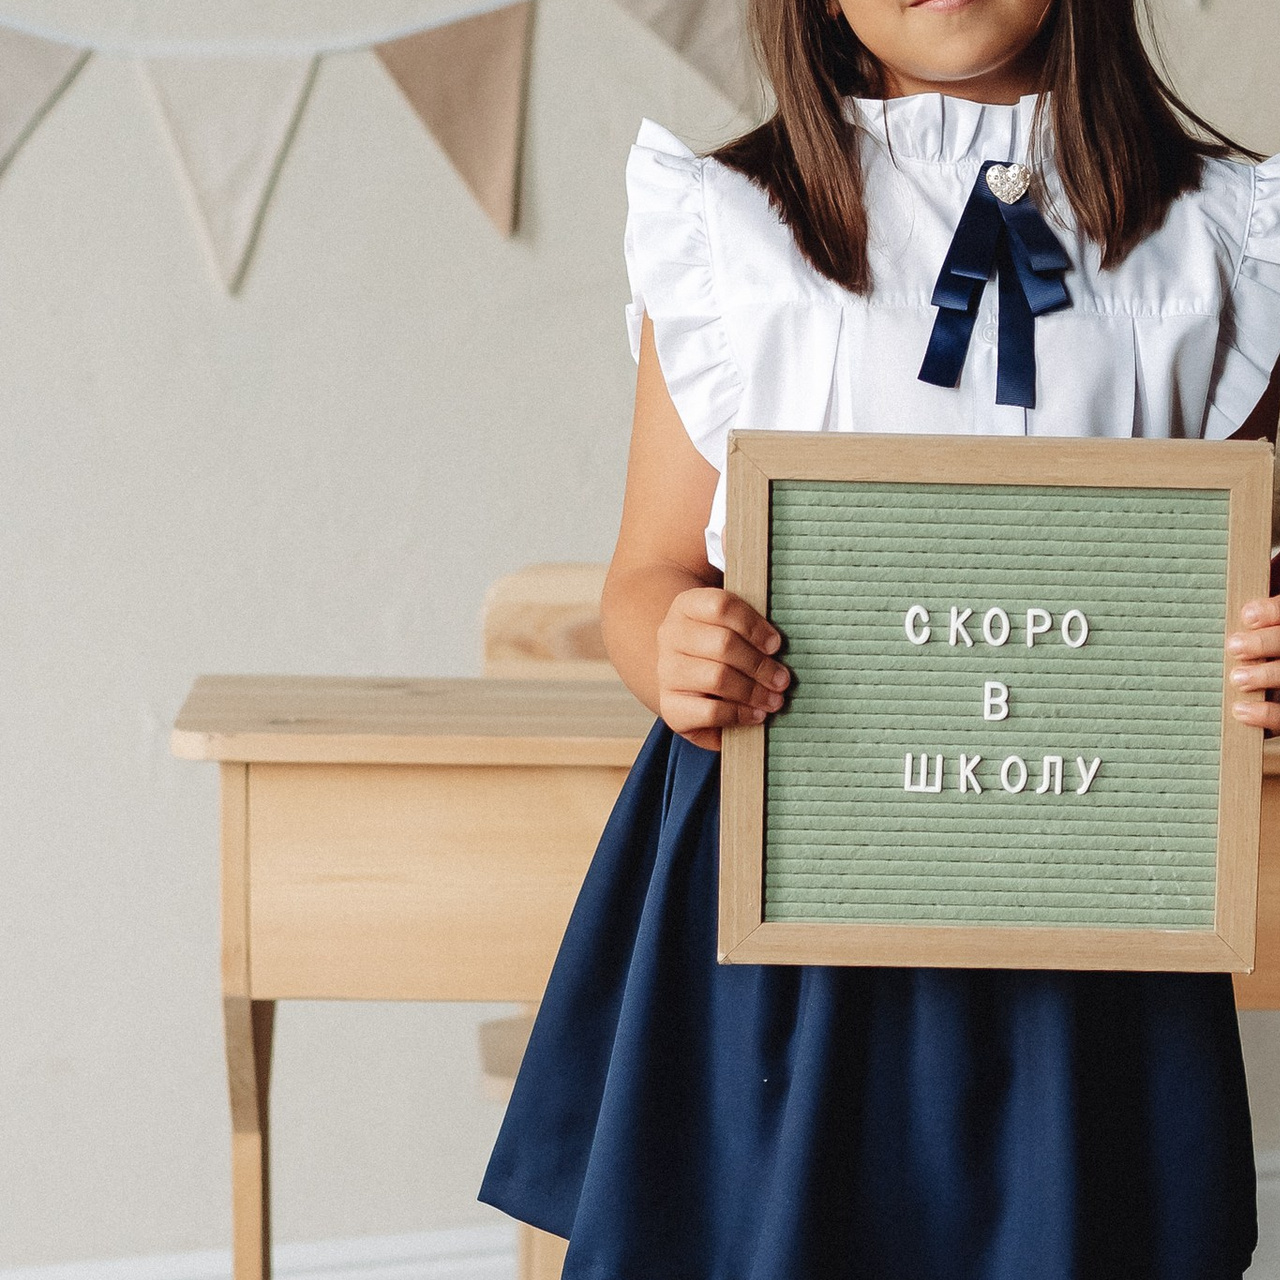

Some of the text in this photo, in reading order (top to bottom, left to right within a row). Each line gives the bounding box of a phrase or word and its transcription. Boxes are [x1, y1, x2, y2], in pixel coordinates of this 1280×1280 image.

[904, 604, 1090, 649] СКОРО
[983, 680, 1010, 722] В
[903, 751, 1102, 796] ШКОЛУ
